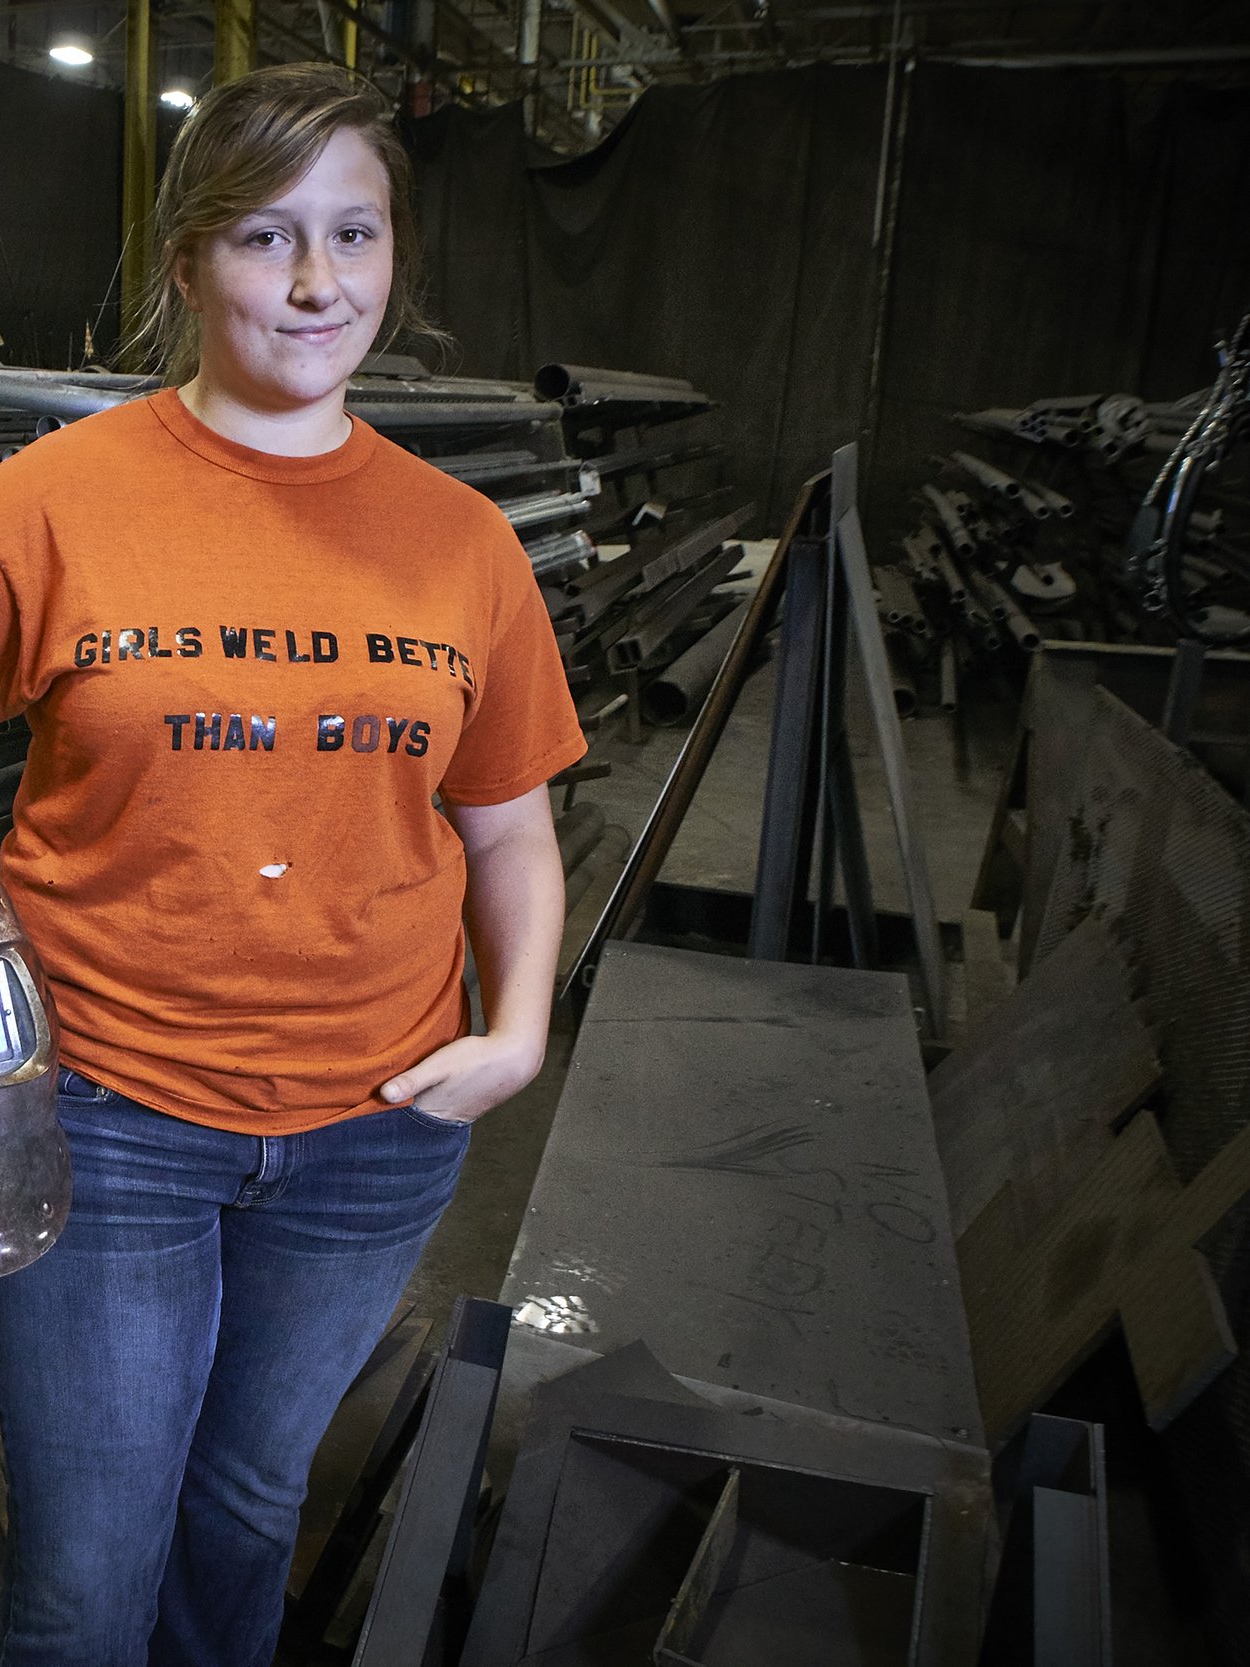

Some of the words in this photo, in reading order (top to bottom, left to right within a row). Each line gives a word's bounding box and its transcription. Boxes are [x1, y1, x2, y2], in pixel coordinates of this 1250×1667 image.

[74, 626, 203, 668] GIRLS
[219, 625, 339, 664] WELD
[164, 712, 277, 751] THAN
[316, 714, 431, 758] BOYS
